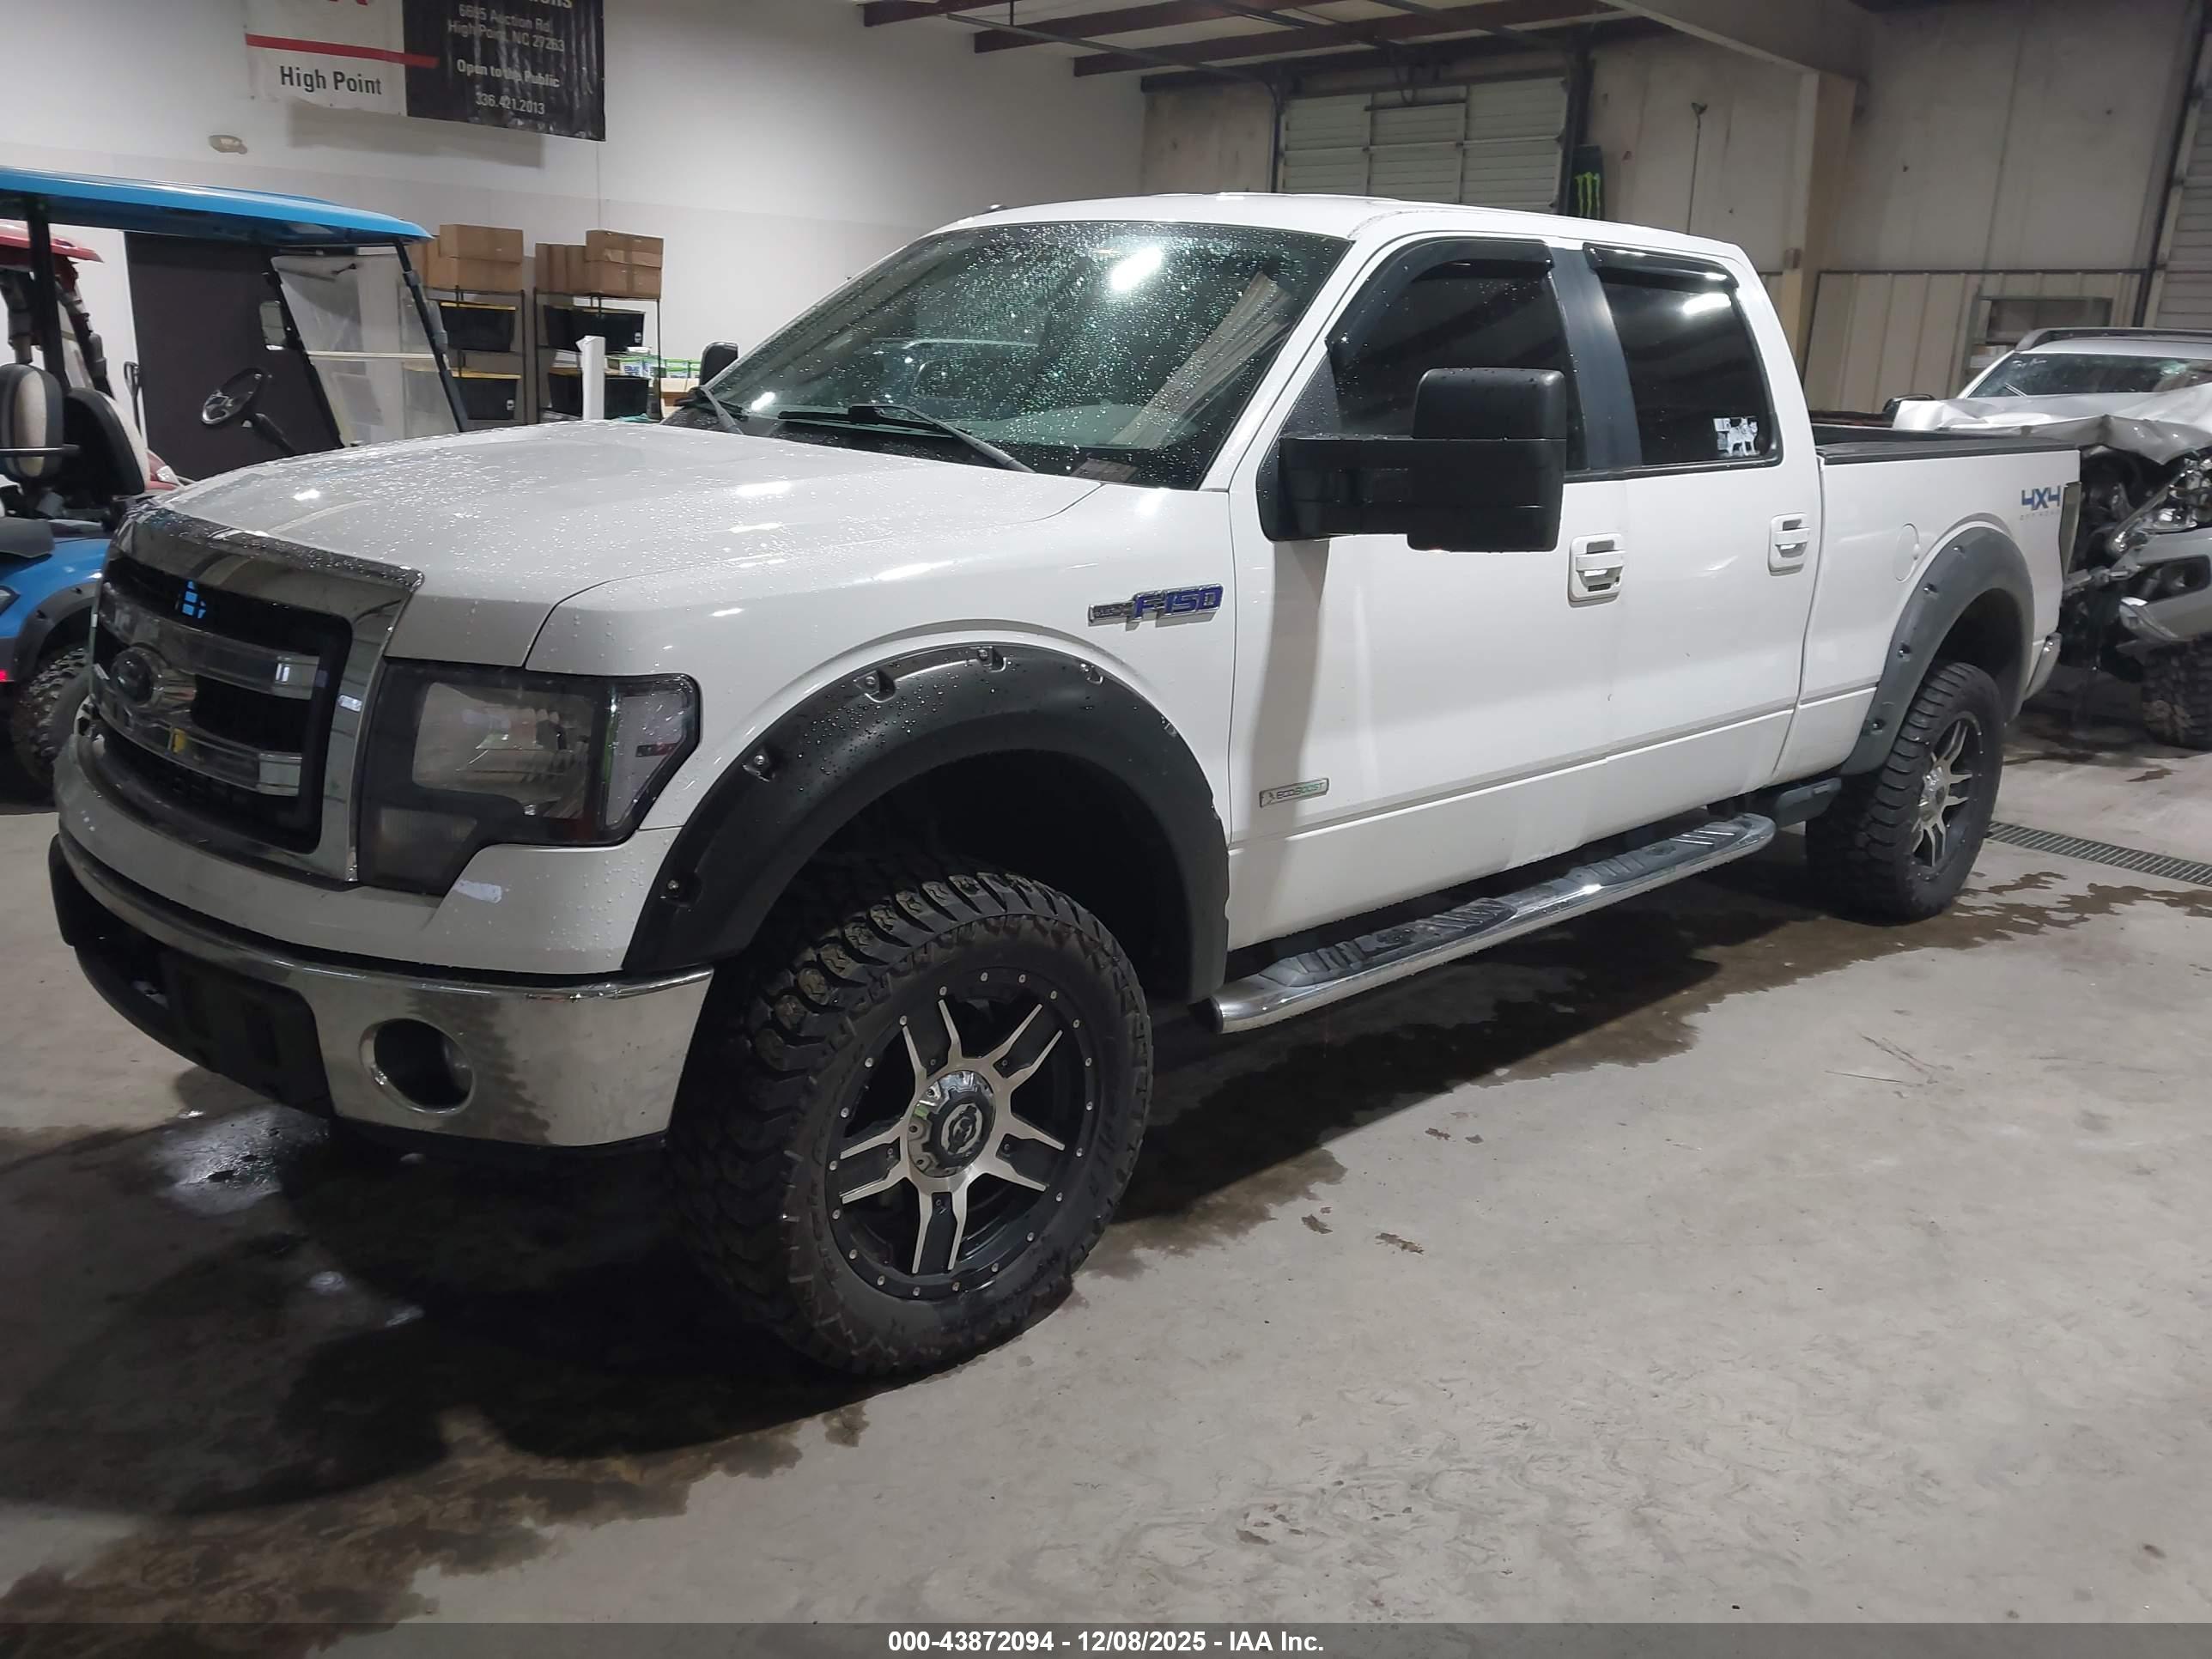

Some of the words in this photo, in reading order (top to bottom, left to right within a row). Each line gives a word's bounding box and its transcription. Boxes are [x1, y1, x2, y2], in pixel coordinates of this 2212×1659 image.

[512, 30, 530, 46] NC
[280, 65, 326, 93] High
[333, 71, 382, 94] Point
[457, 59, 488, 76] Open
[490, 65, 502, 78] to
[524, 70, 561, 88] Public
